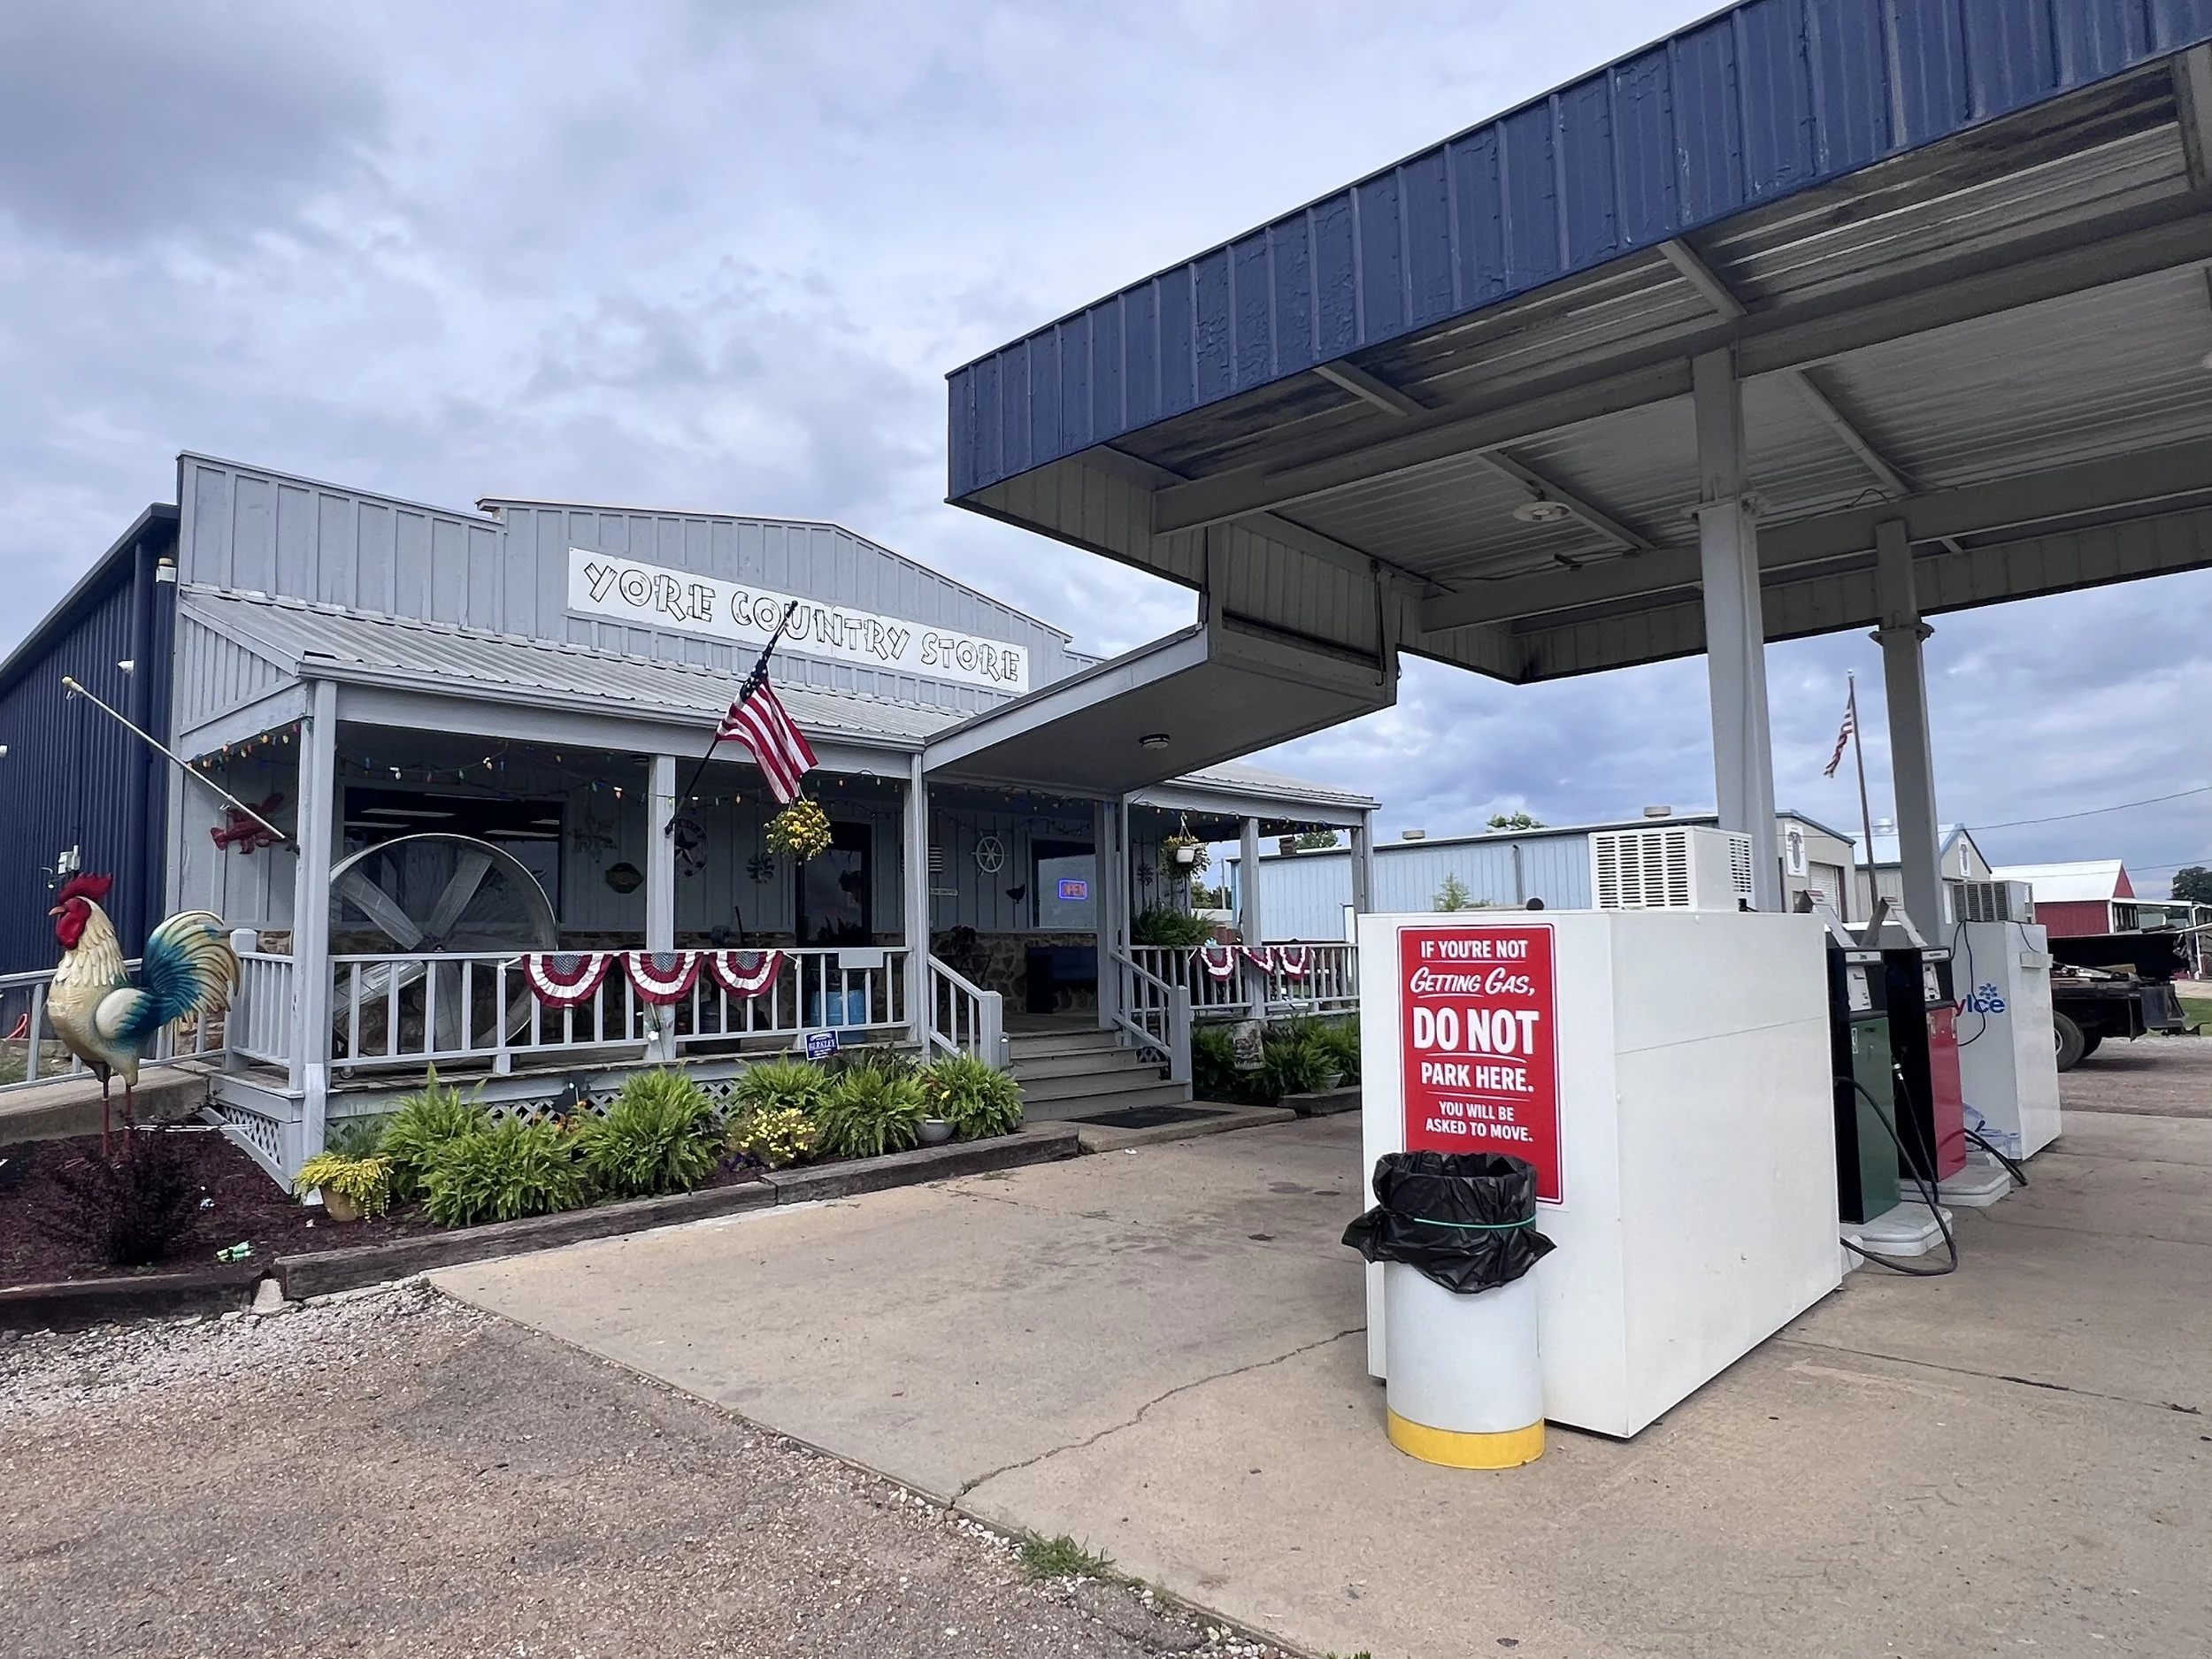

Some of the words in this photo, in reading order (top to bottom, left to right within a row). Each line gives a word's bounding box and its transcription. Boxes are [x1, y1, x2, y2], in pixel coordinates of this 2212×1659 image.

[584, 562, 716, 623] YORE
[731, 590, 910, 661] COUNTRY
[921, 632, 1020, 681] STORE
[1420, 940, 1435, 958] IF
[1437, 940, 1492, 958] YOU'RE
[1495, 940, 1528, 958] NOT
[1412, 1006, 1460, 1051] DO
[1466, 1008, 1540, 1055] NOT
[1421, 1061, 1471, 1087] PARK
[1476, 1065, 1534, 1093] HERE.
[1438, 1100, 1463, 1118] YOU
[1465, 1102, 1495, 1120] WILL
[1498, 1106, 1515, 1122] BE
[1425, 1118, 1467, 1135] ASKED
[1469, 1121, 1486, 1137] TO
[1490, 1124, 1533, 1142] MOVE.
